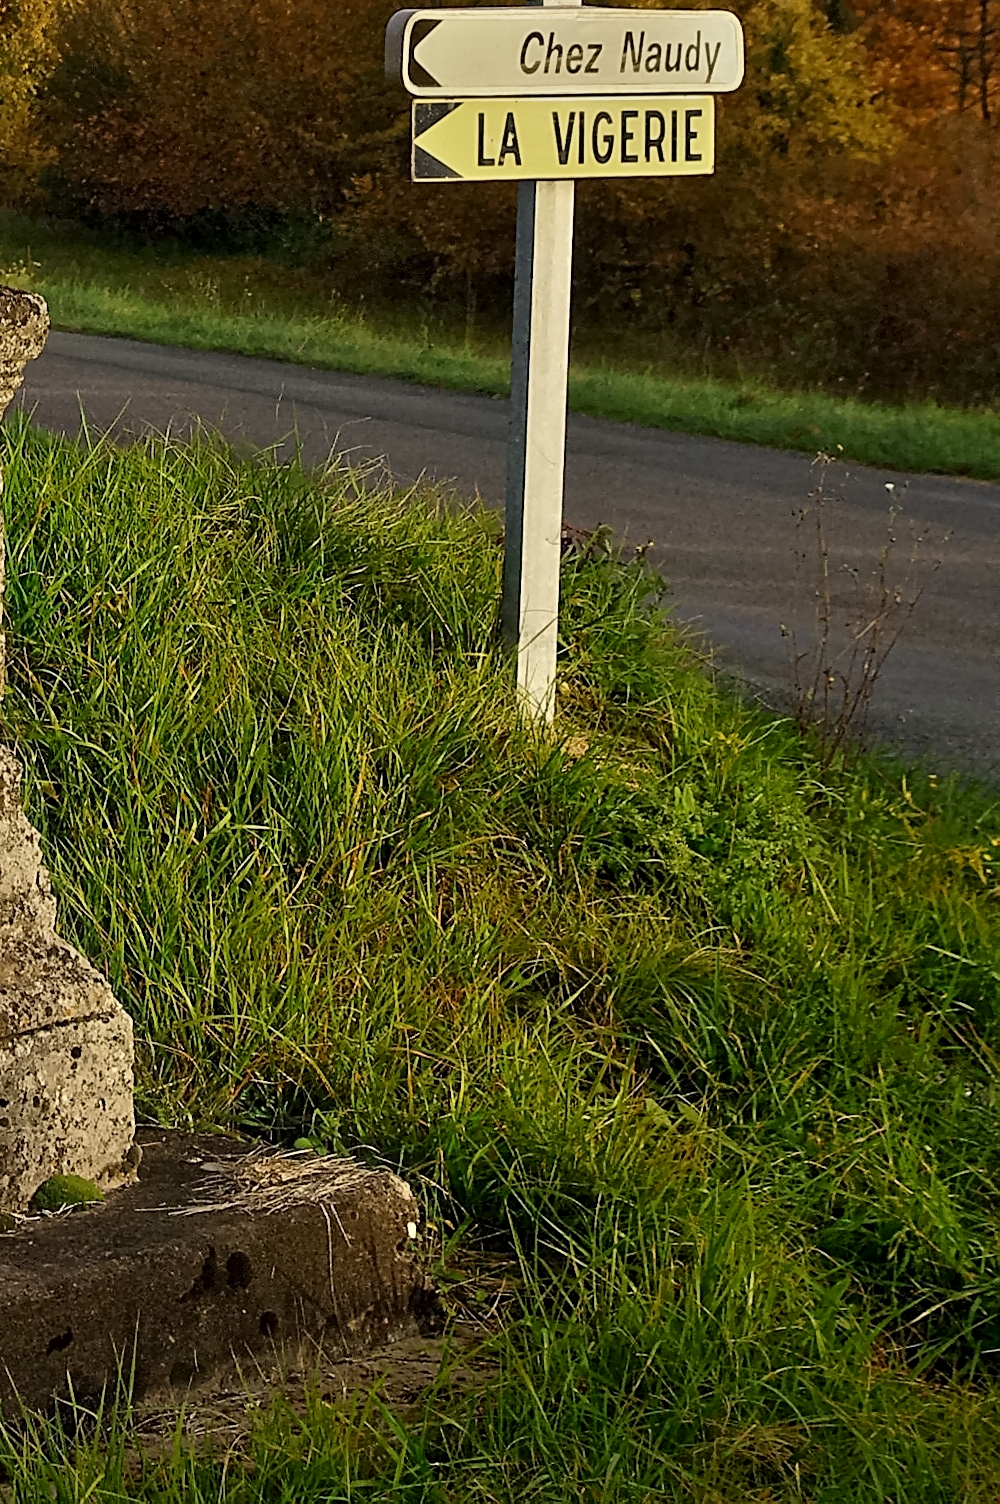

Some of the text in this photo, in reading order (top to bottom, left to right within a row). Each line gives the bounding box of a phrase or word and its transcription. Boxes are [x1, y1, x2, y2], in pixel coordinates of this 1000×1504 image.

[519, 30, 722, 84] Chez Naudy
[477, 108, 703, 167] LA VIGERIE
